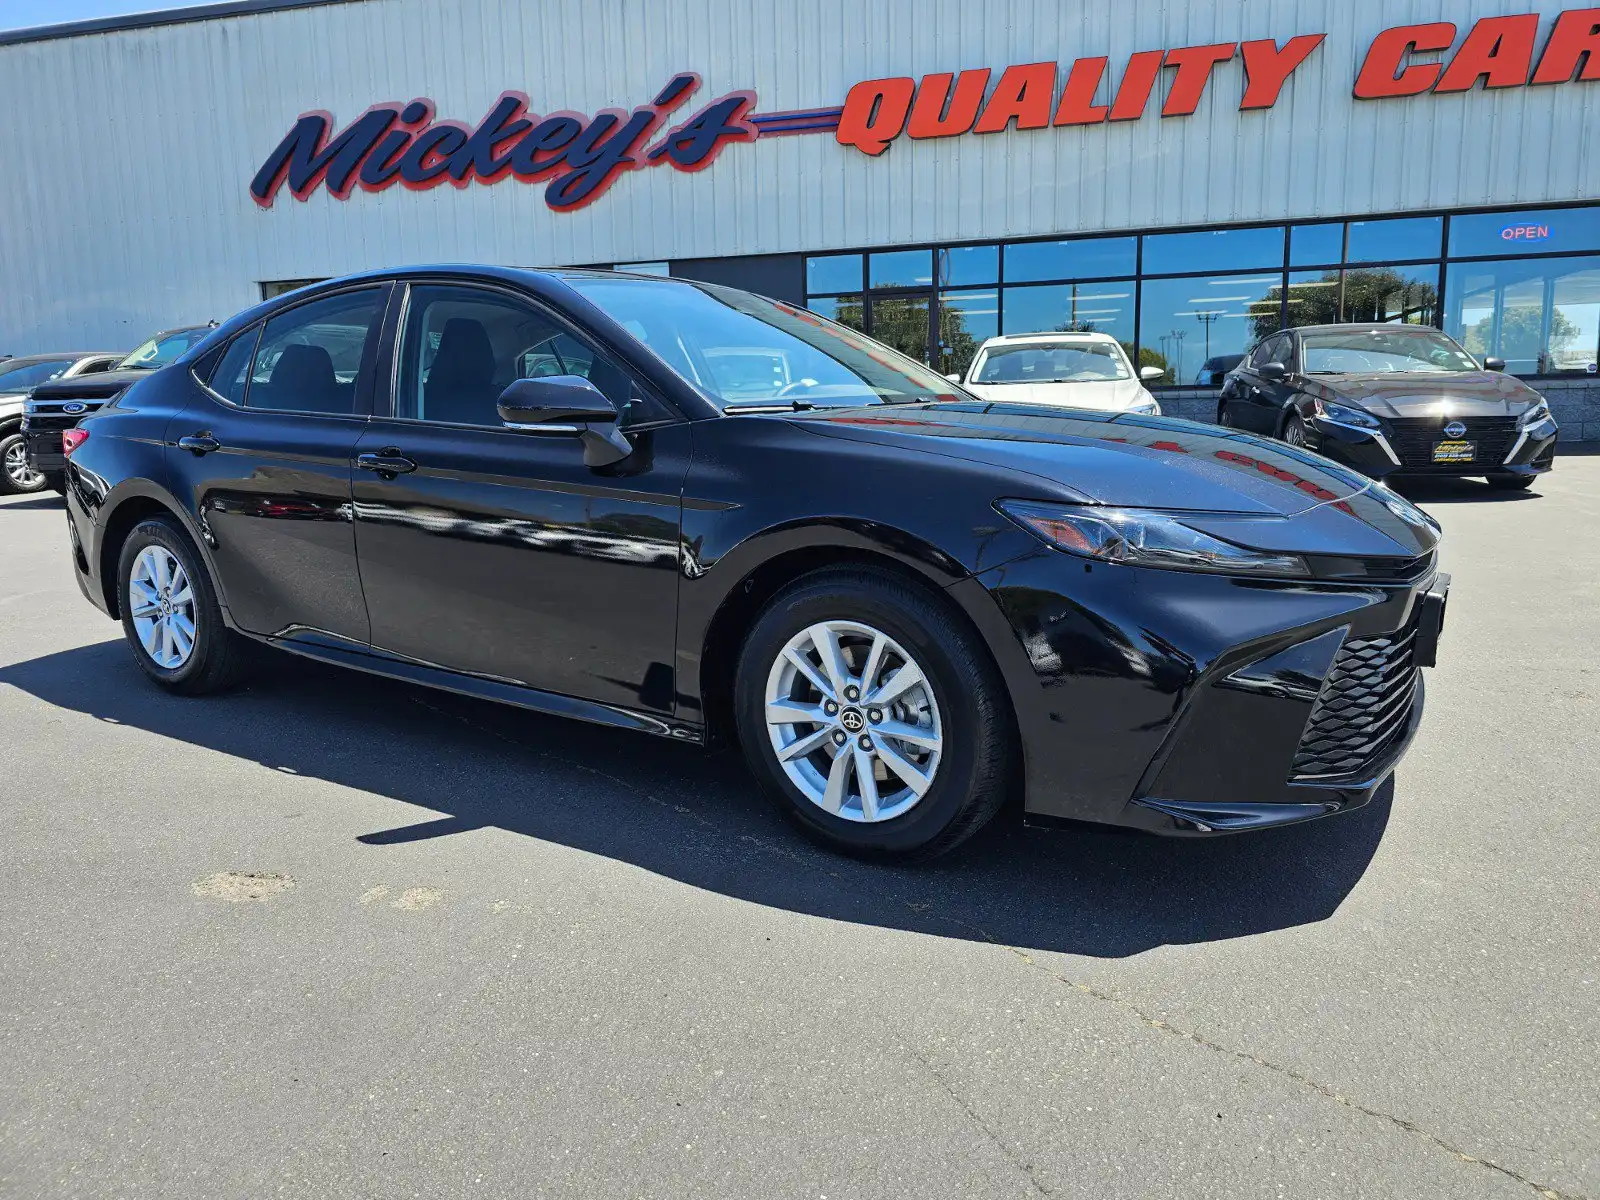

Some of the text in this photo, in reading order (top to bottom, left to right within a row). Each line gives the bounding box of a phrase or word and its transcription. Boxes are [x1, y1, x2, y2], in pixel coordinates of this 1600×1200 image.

[249, 8, 1600, 210] Mickey's QUALITY CAR
[1501, 225, 1548, 240] OPEN
